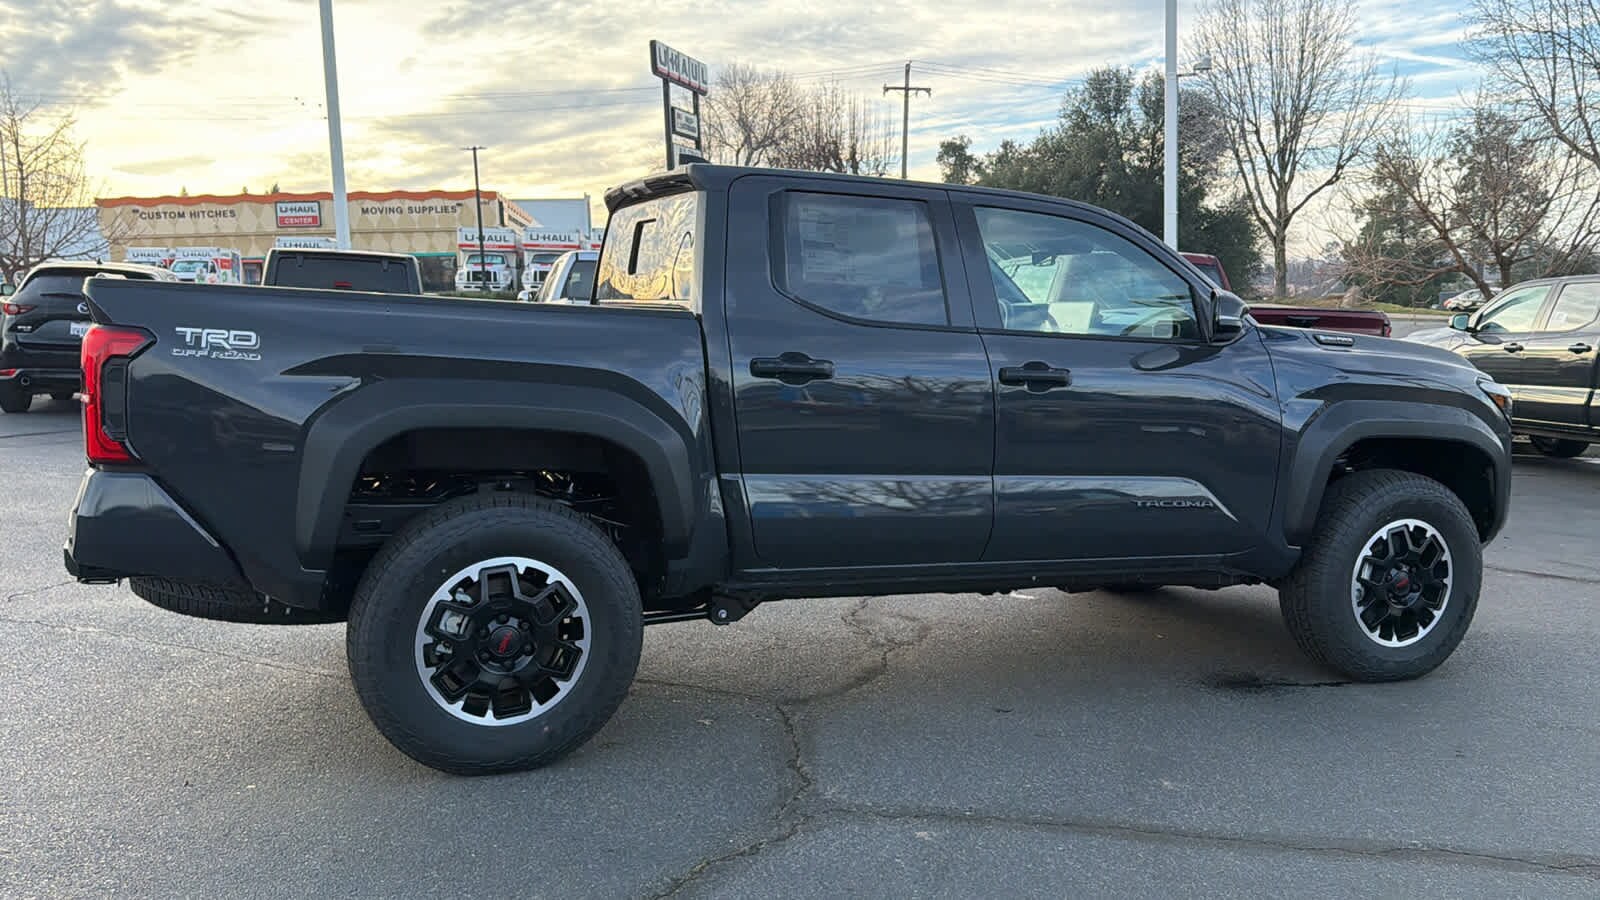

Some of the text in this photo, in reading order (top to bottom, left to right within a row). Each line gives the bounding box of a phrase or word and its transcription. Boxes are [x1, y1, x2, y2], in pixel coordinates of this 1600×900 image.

[658, 45, 707, 85] U-HAUL
[279, 204, 316, 213] U-HAUL
[361, 205, 457, 215] MOVING SUPPLIES
[189, 209, 236, 218] HITCHES
[529, 233, 574, 242] U-HAUL
[175, 326, 260, 350] TRD
[172, 348, 261, 361] OFF ROAD
[1136, 499, 1214, 507] TACOMA
